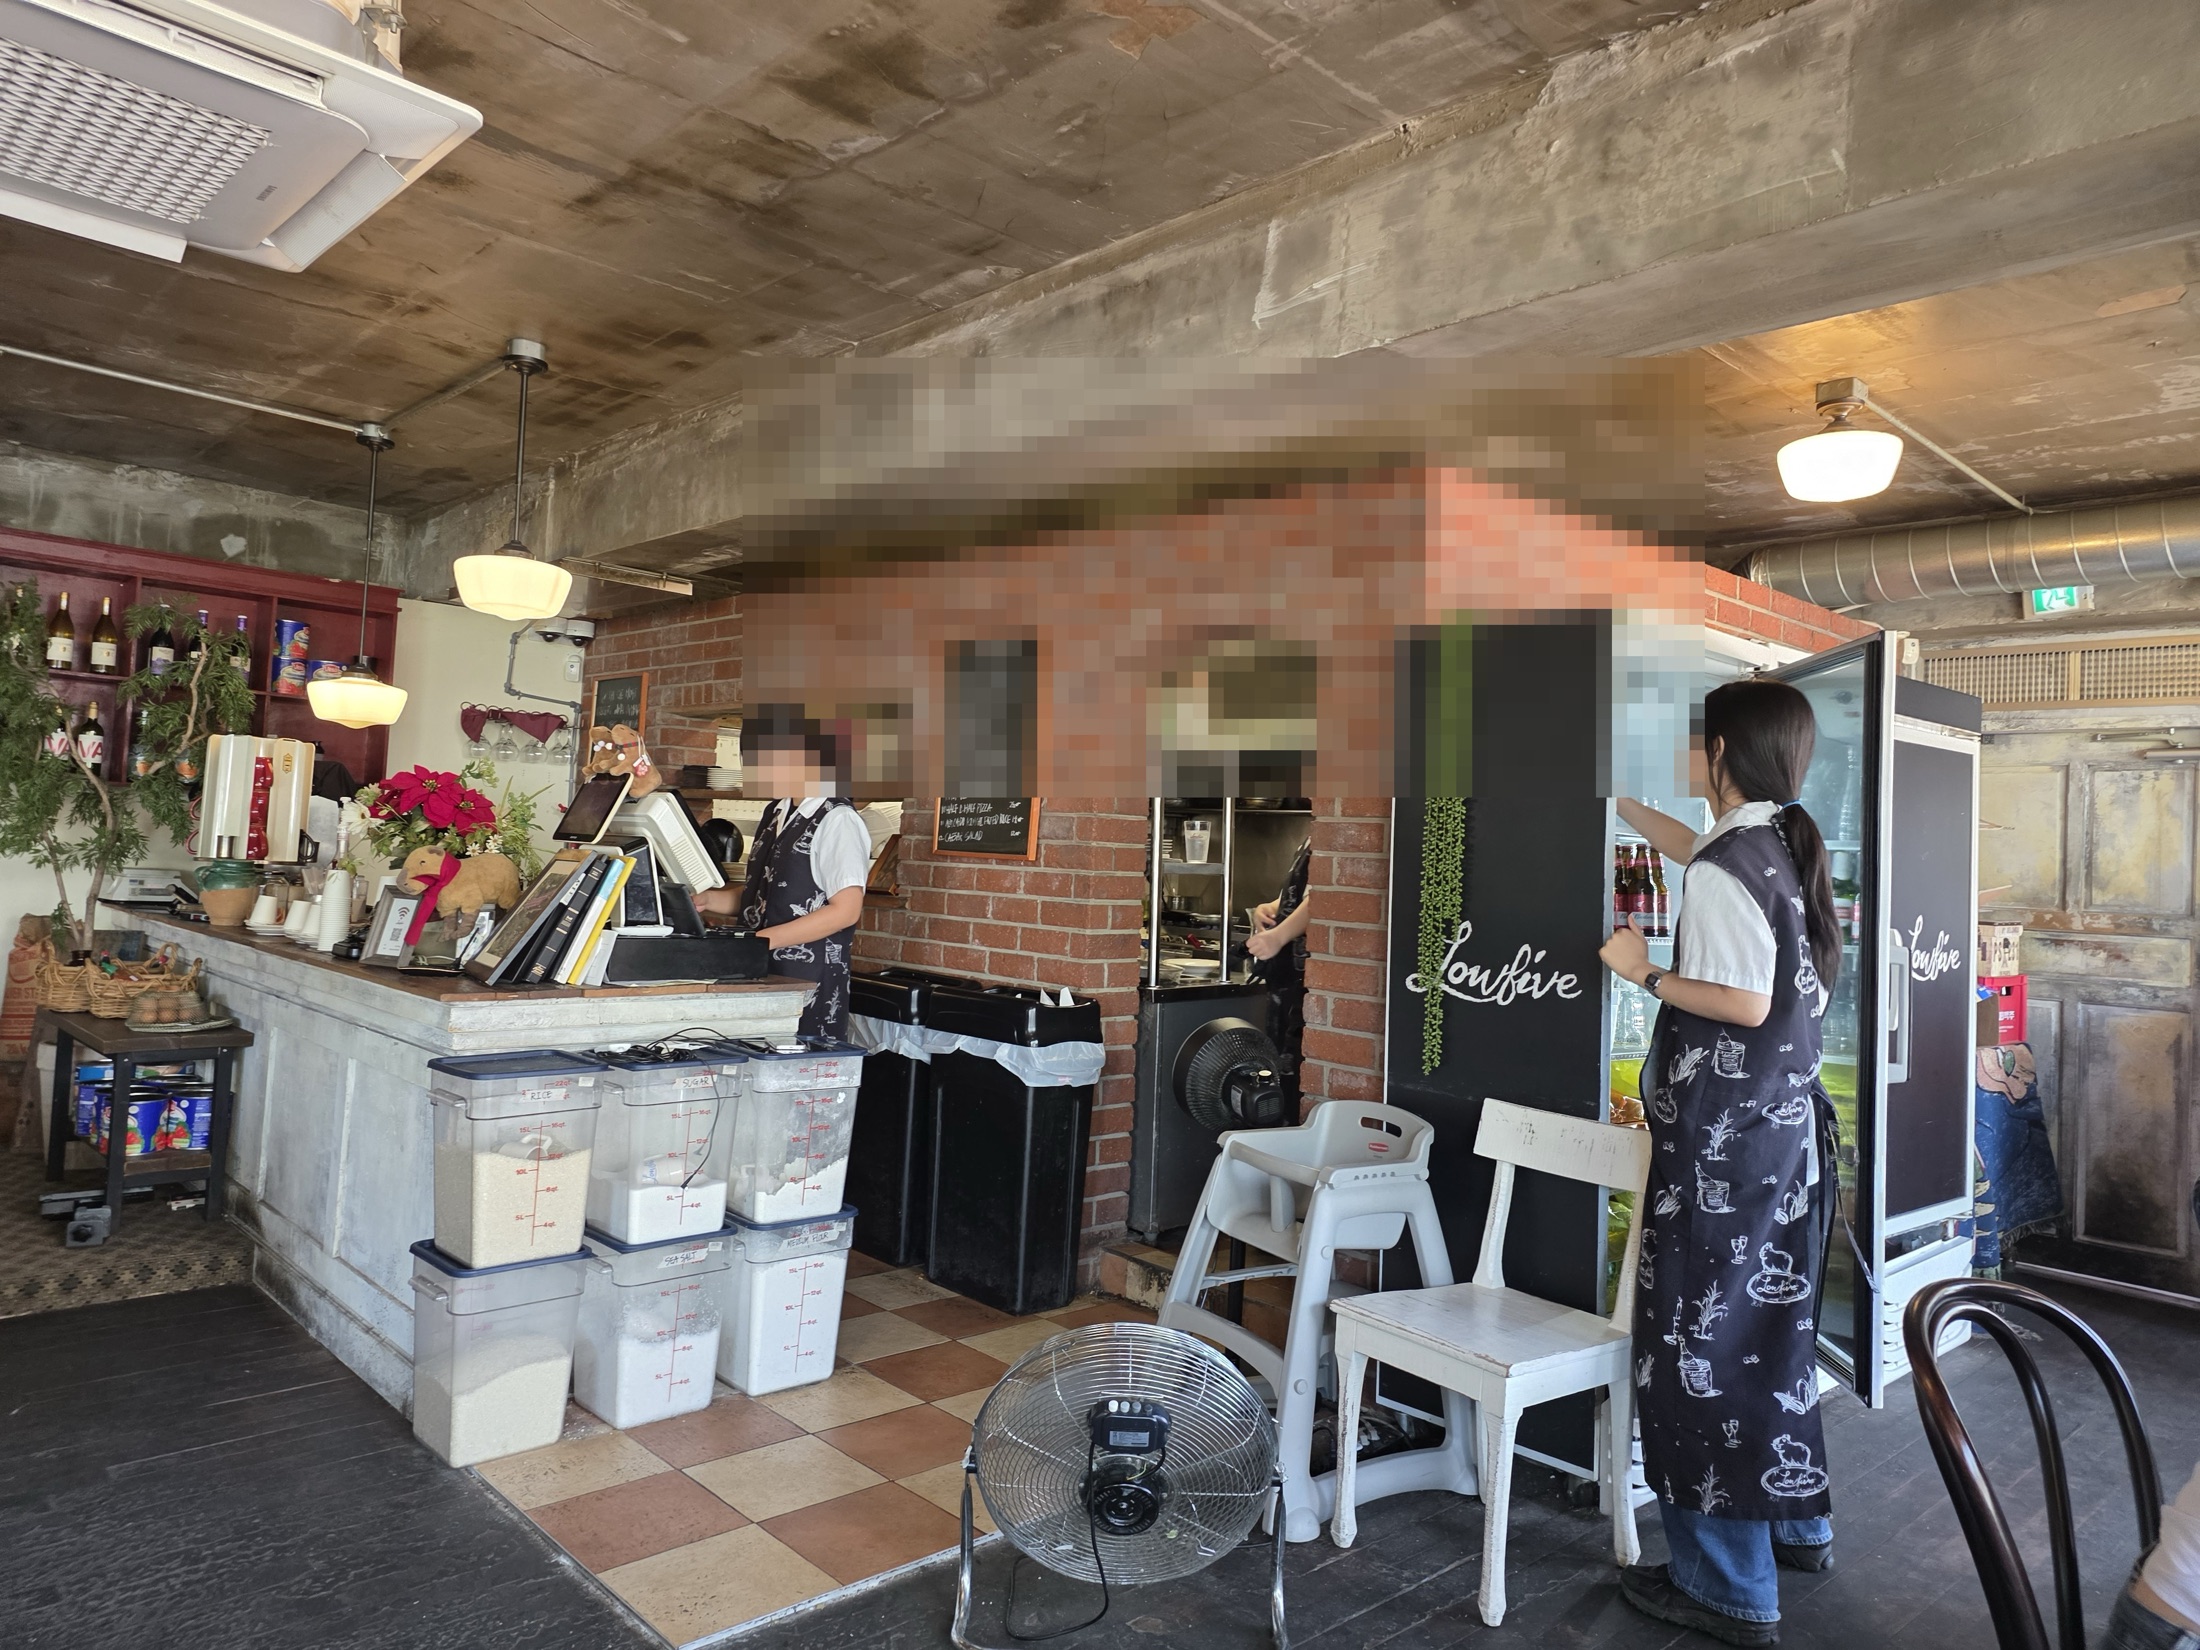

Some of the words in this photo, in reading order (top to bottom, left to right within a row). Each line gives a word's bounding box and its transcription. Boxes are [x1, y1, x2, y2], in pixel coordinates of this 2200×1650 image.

[1908, 915, 1961, 981] Lowfive
[1405, 920, 1582, 1006] Lowfive
[682, 1077, 709, 1088] SUGAR
[530, 1090, 552, 1101] RICE
[664, 1255, 679, 1266] SEA
[680, 1251, 697, 1264] SALT
